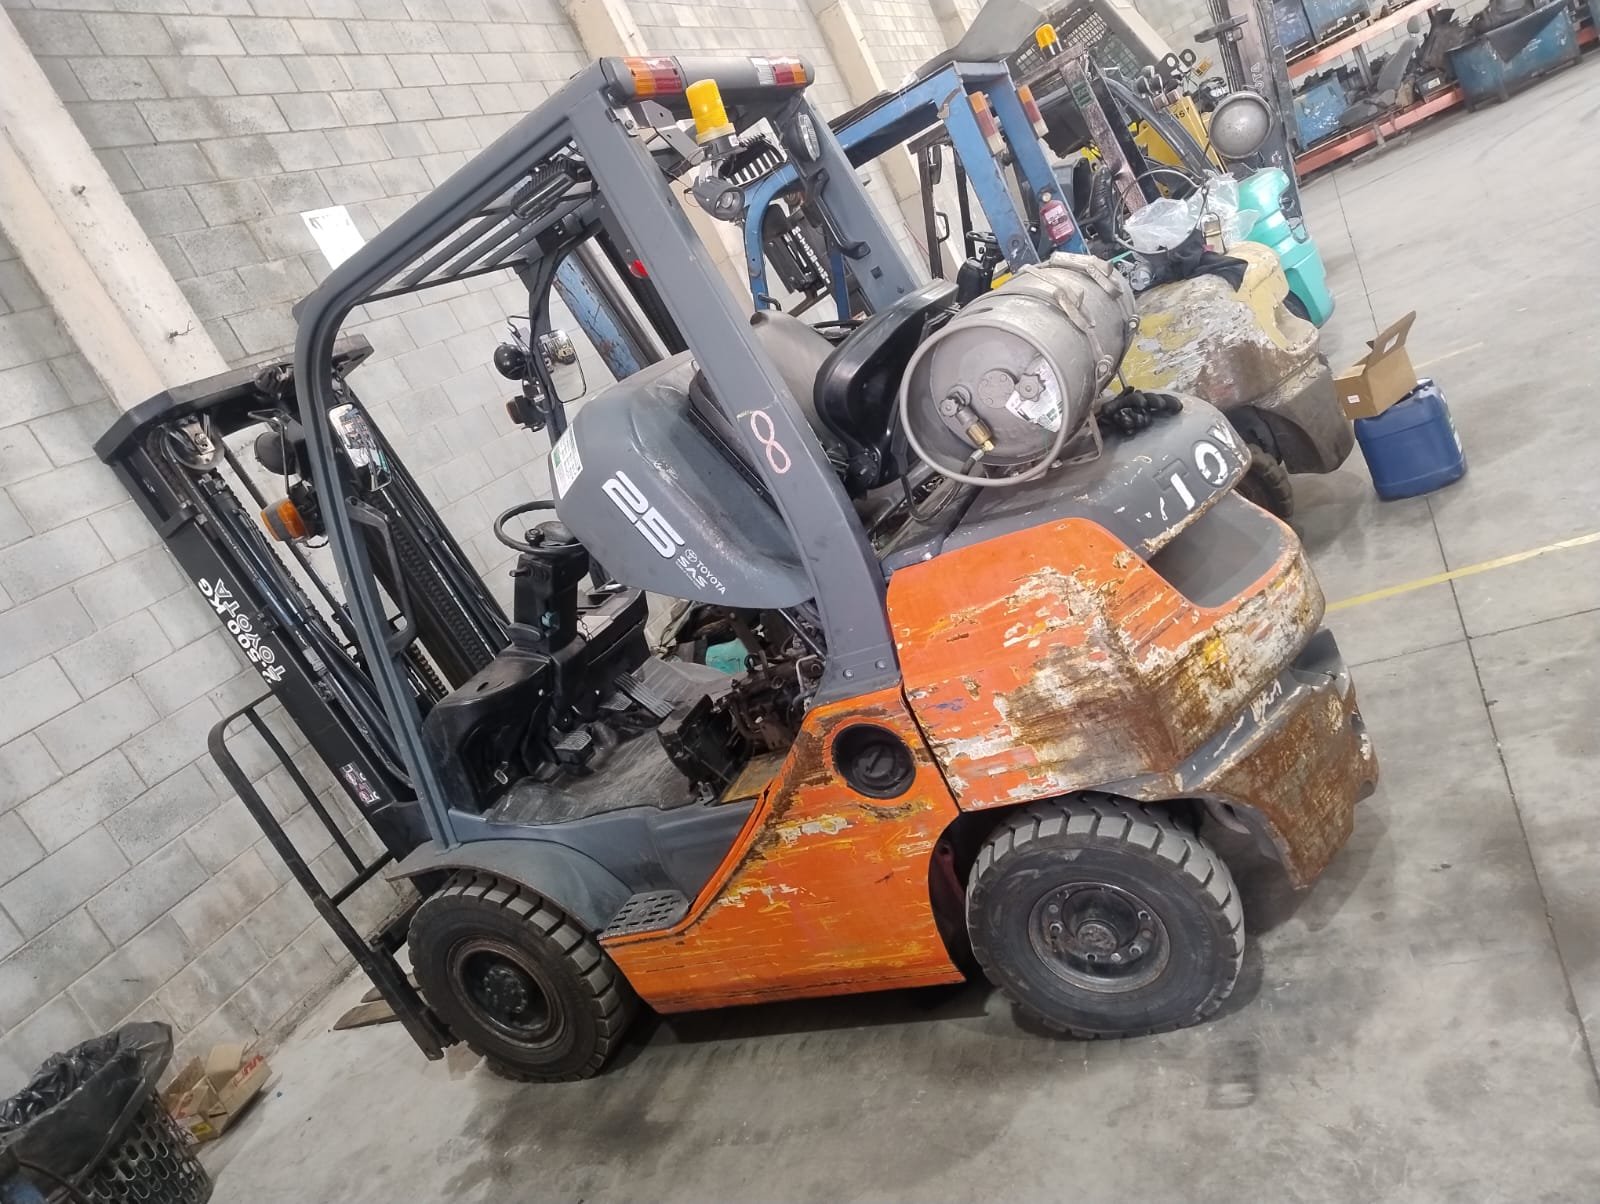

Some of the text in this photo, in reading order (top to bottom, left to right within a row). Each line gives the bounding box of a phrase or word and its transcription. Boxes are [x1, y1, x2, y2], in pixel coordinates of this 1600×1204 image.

[750, 410, 791, 474] 8
[601, 470, 685, 559] 25
[677, 555, 708, 589] SAS
[695, 560, 727, 595] TOYOTA
[198, 577, 275, 684] 2.500 KG
[213, 578, 286, 683] TOYOTA
